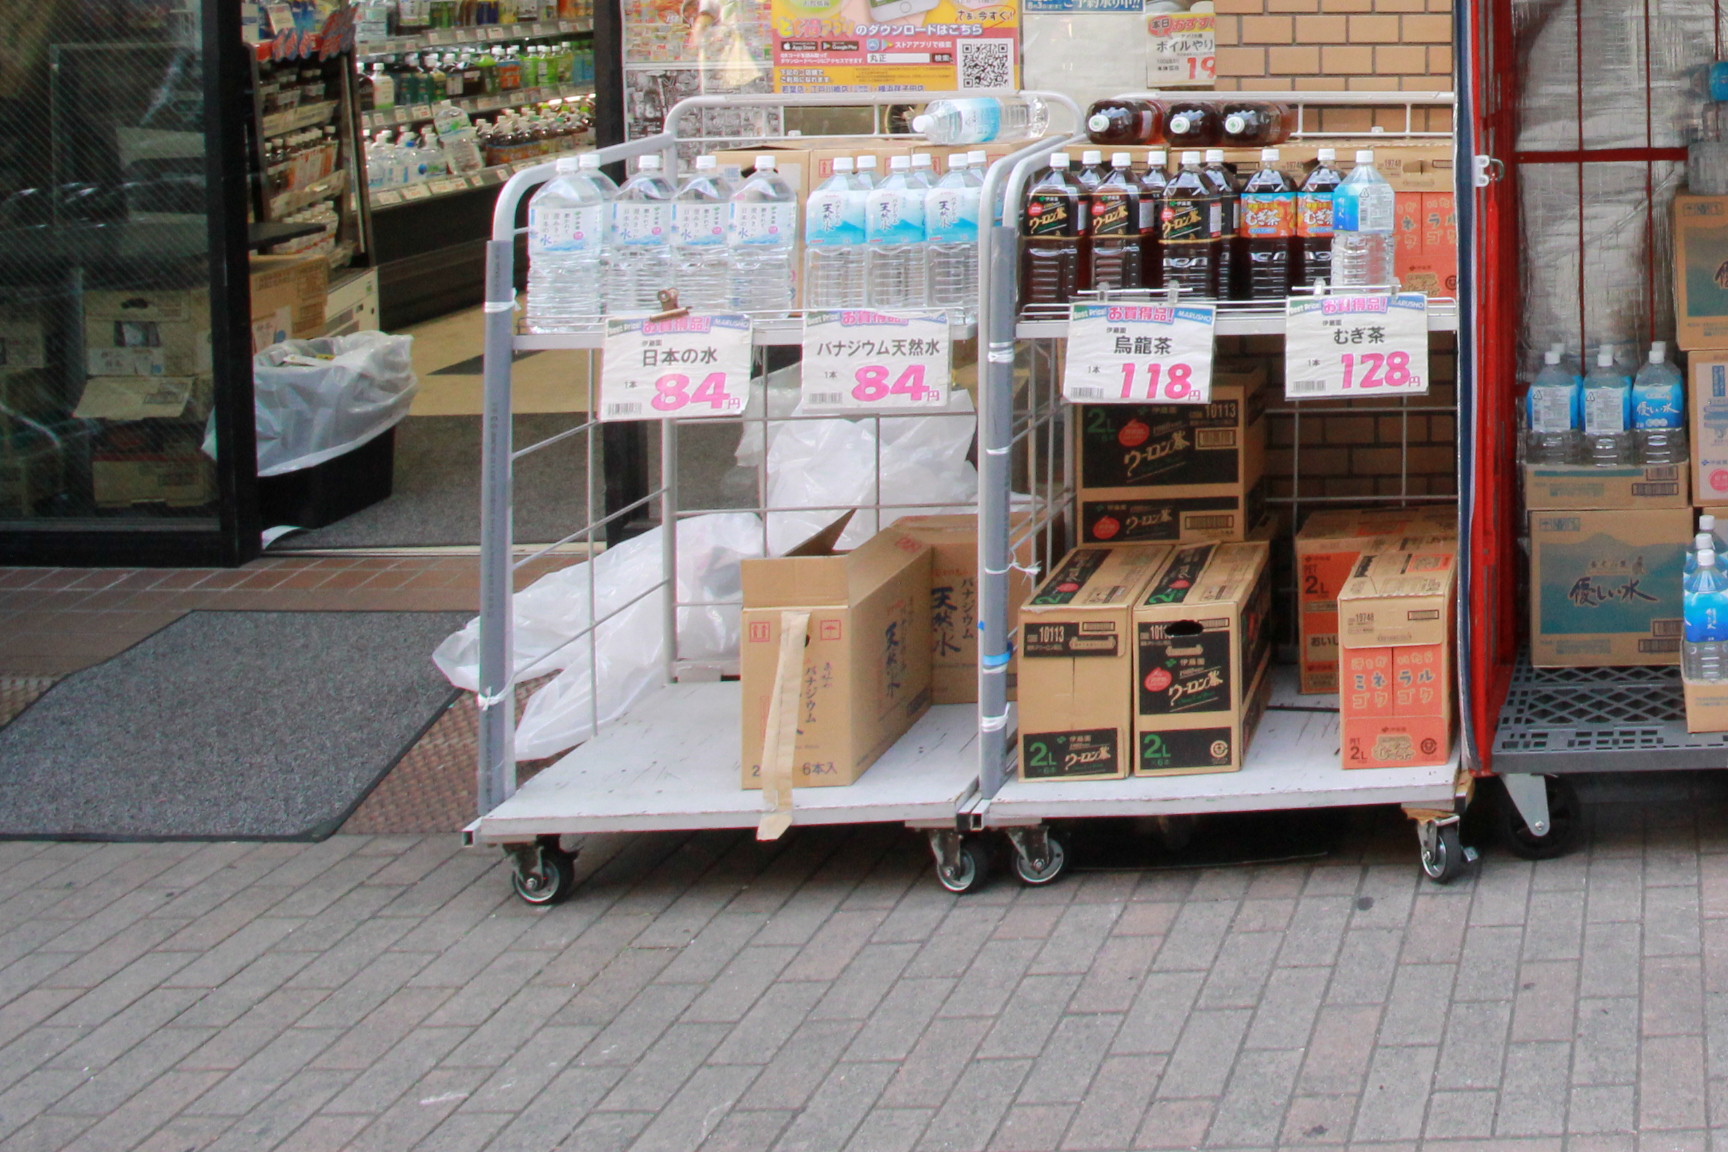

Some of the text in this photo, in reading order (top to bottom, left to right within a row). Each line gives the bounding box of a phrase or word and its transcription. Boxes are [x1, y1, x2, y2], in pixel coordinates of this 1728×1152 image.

[1246, 210, 1281, 226] むぎ茶
[1333, 326, 1385, 345] むぎ茶
[817, 338, 940, 356] バナジウム天然水
[1113, 336, 1172, 355] 烏龍茶
[642, 348, 717, 367] 日本の水
[1205, 403, 1236, 418] 10113
[1305, 575, 1329, 595] 2L
[1569, 577, 1658, 606] 優しい水
[1039, 626, 1065, 643] 10113
[1354, 669, 1435, 690] ミネラル
[1029, 742, 1056, 767] 2L
[1143, 734, 1171, 759] 2L
[1350, 746, 1367, 760] 2L
